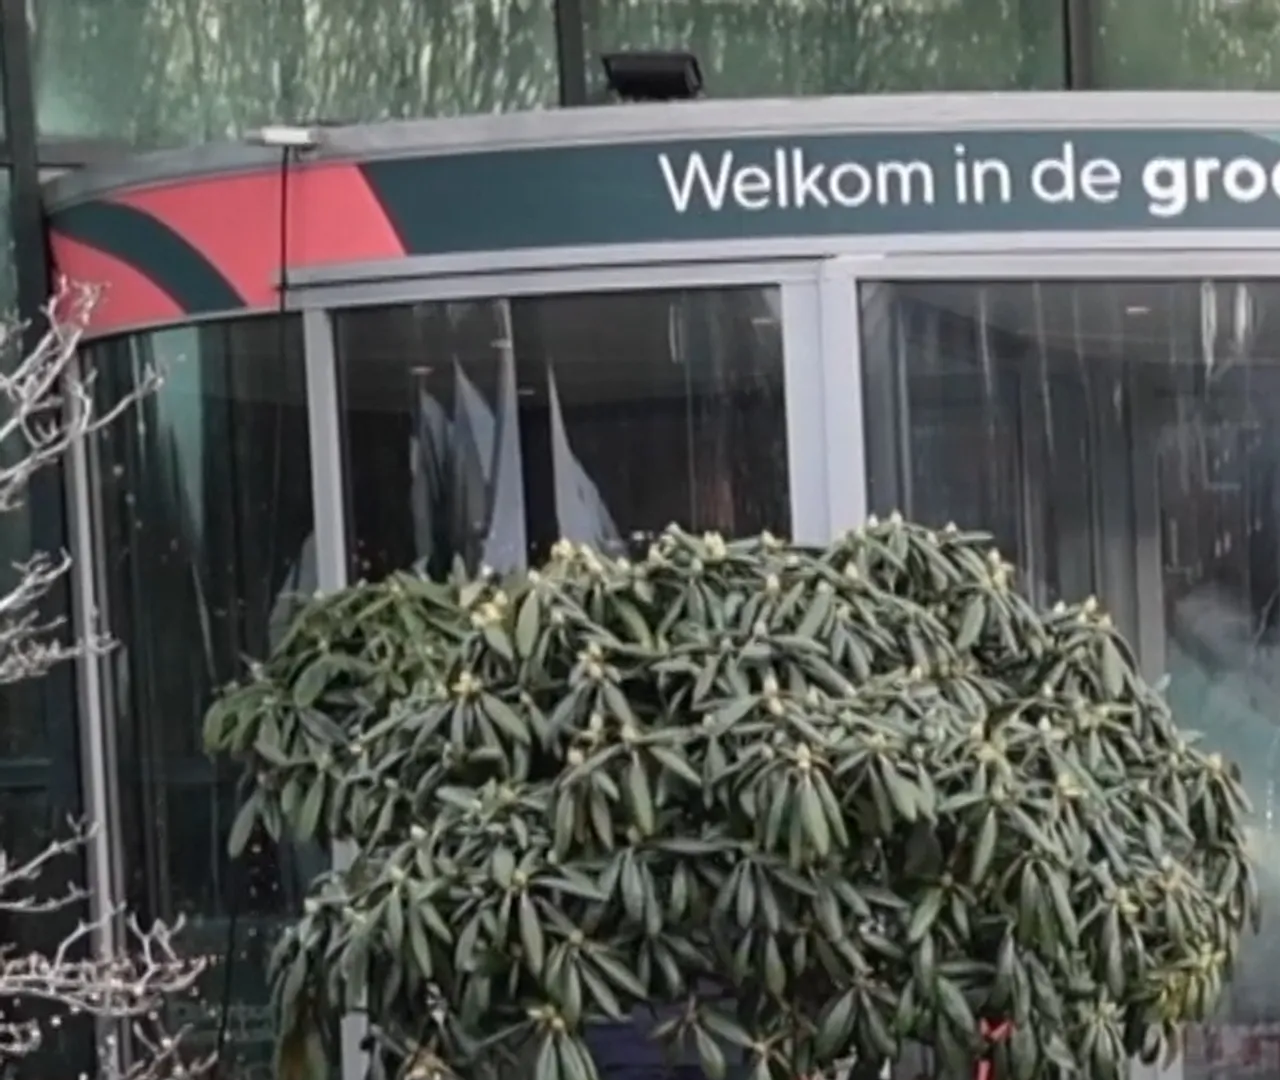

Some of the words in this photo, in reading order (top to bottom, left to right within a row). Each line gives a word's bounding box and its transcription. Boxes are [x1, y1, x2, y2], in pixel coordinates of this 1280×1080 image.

[658, 146, 935, 213] Welkom
[953, 142, 1011, 203] in
[1031, 140, 1122, 202] de
